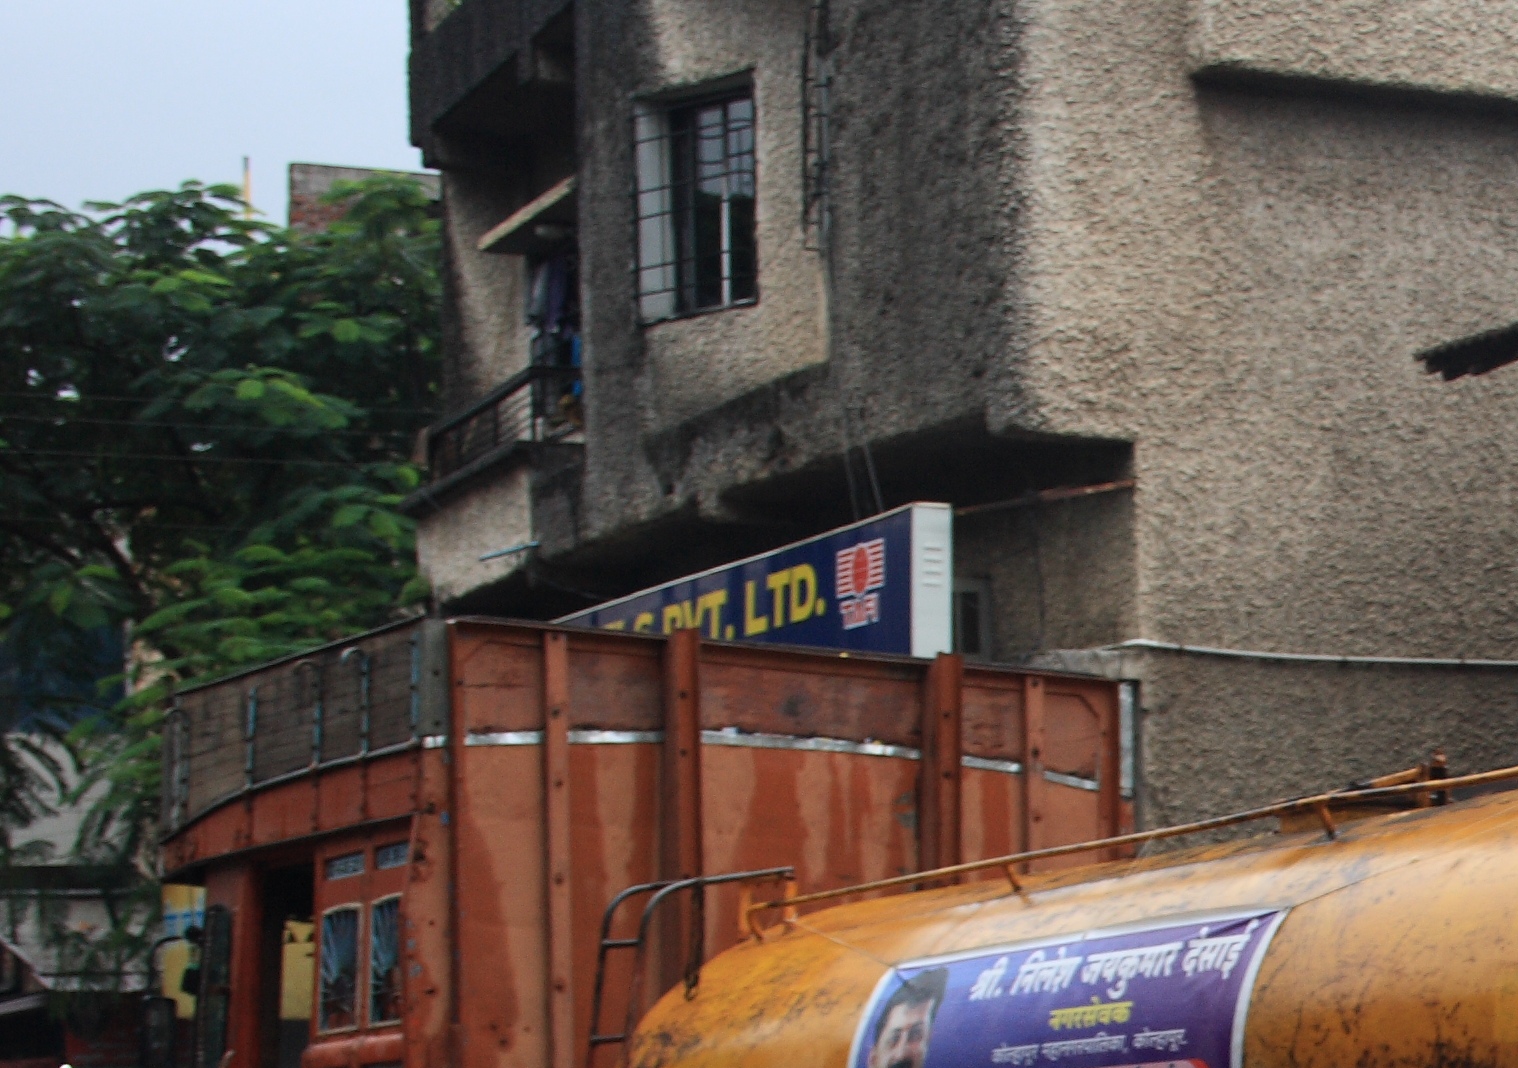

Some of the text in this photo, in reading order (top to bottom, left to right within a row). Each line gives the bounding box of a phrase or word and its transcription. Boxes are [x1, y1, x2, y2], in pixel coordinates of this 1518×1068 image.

[744, 563, 826, 637] LTD.
[968, 956, 1009, 1001] श्री.
[1009, 946, 1082, 996] निलेश
[1081, 941, 1184, 1000] जयकुमार
[1048, 994, 1133, 1031] नगरसेवक
